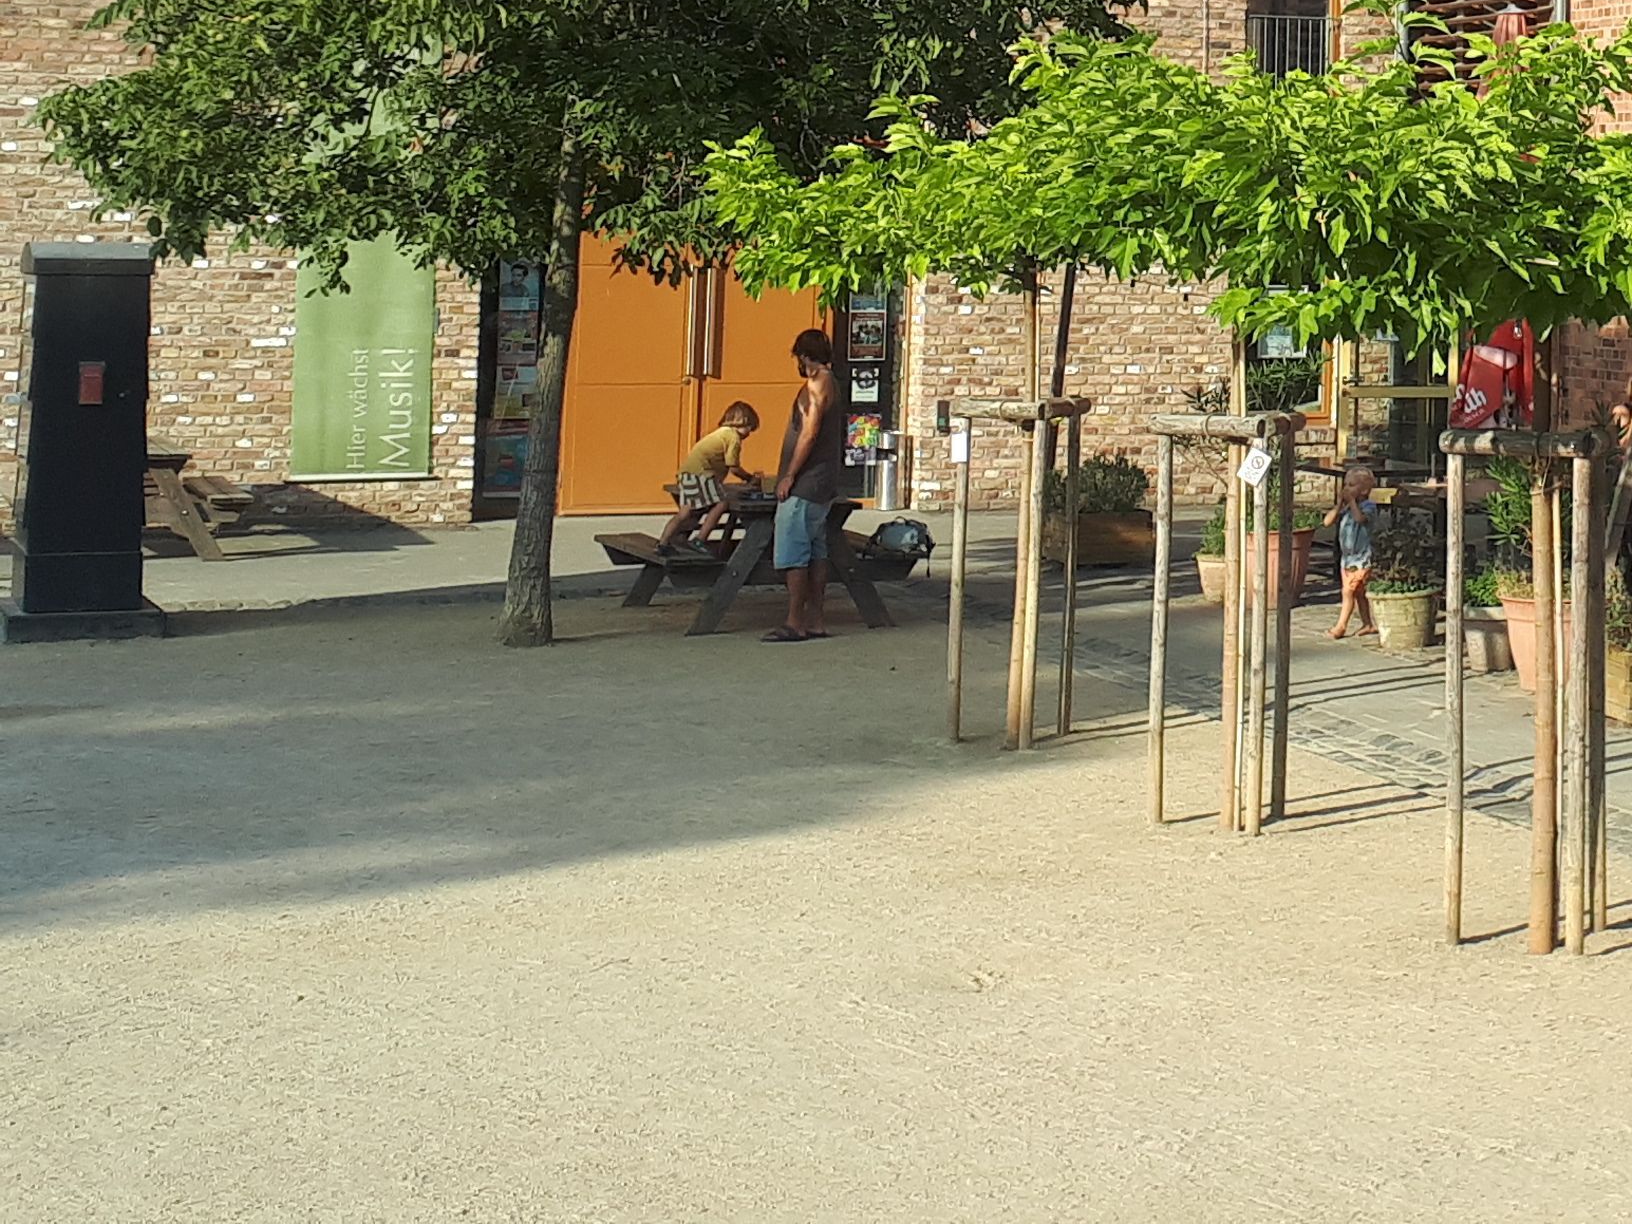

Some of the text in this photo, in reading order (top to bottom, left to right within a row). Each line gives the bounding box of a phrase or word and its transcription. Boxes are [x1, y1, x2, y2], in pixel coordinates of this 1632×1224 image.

[345, 348, 369, 469] Hier wächst
[377, 348, 420, 467] Musik!
